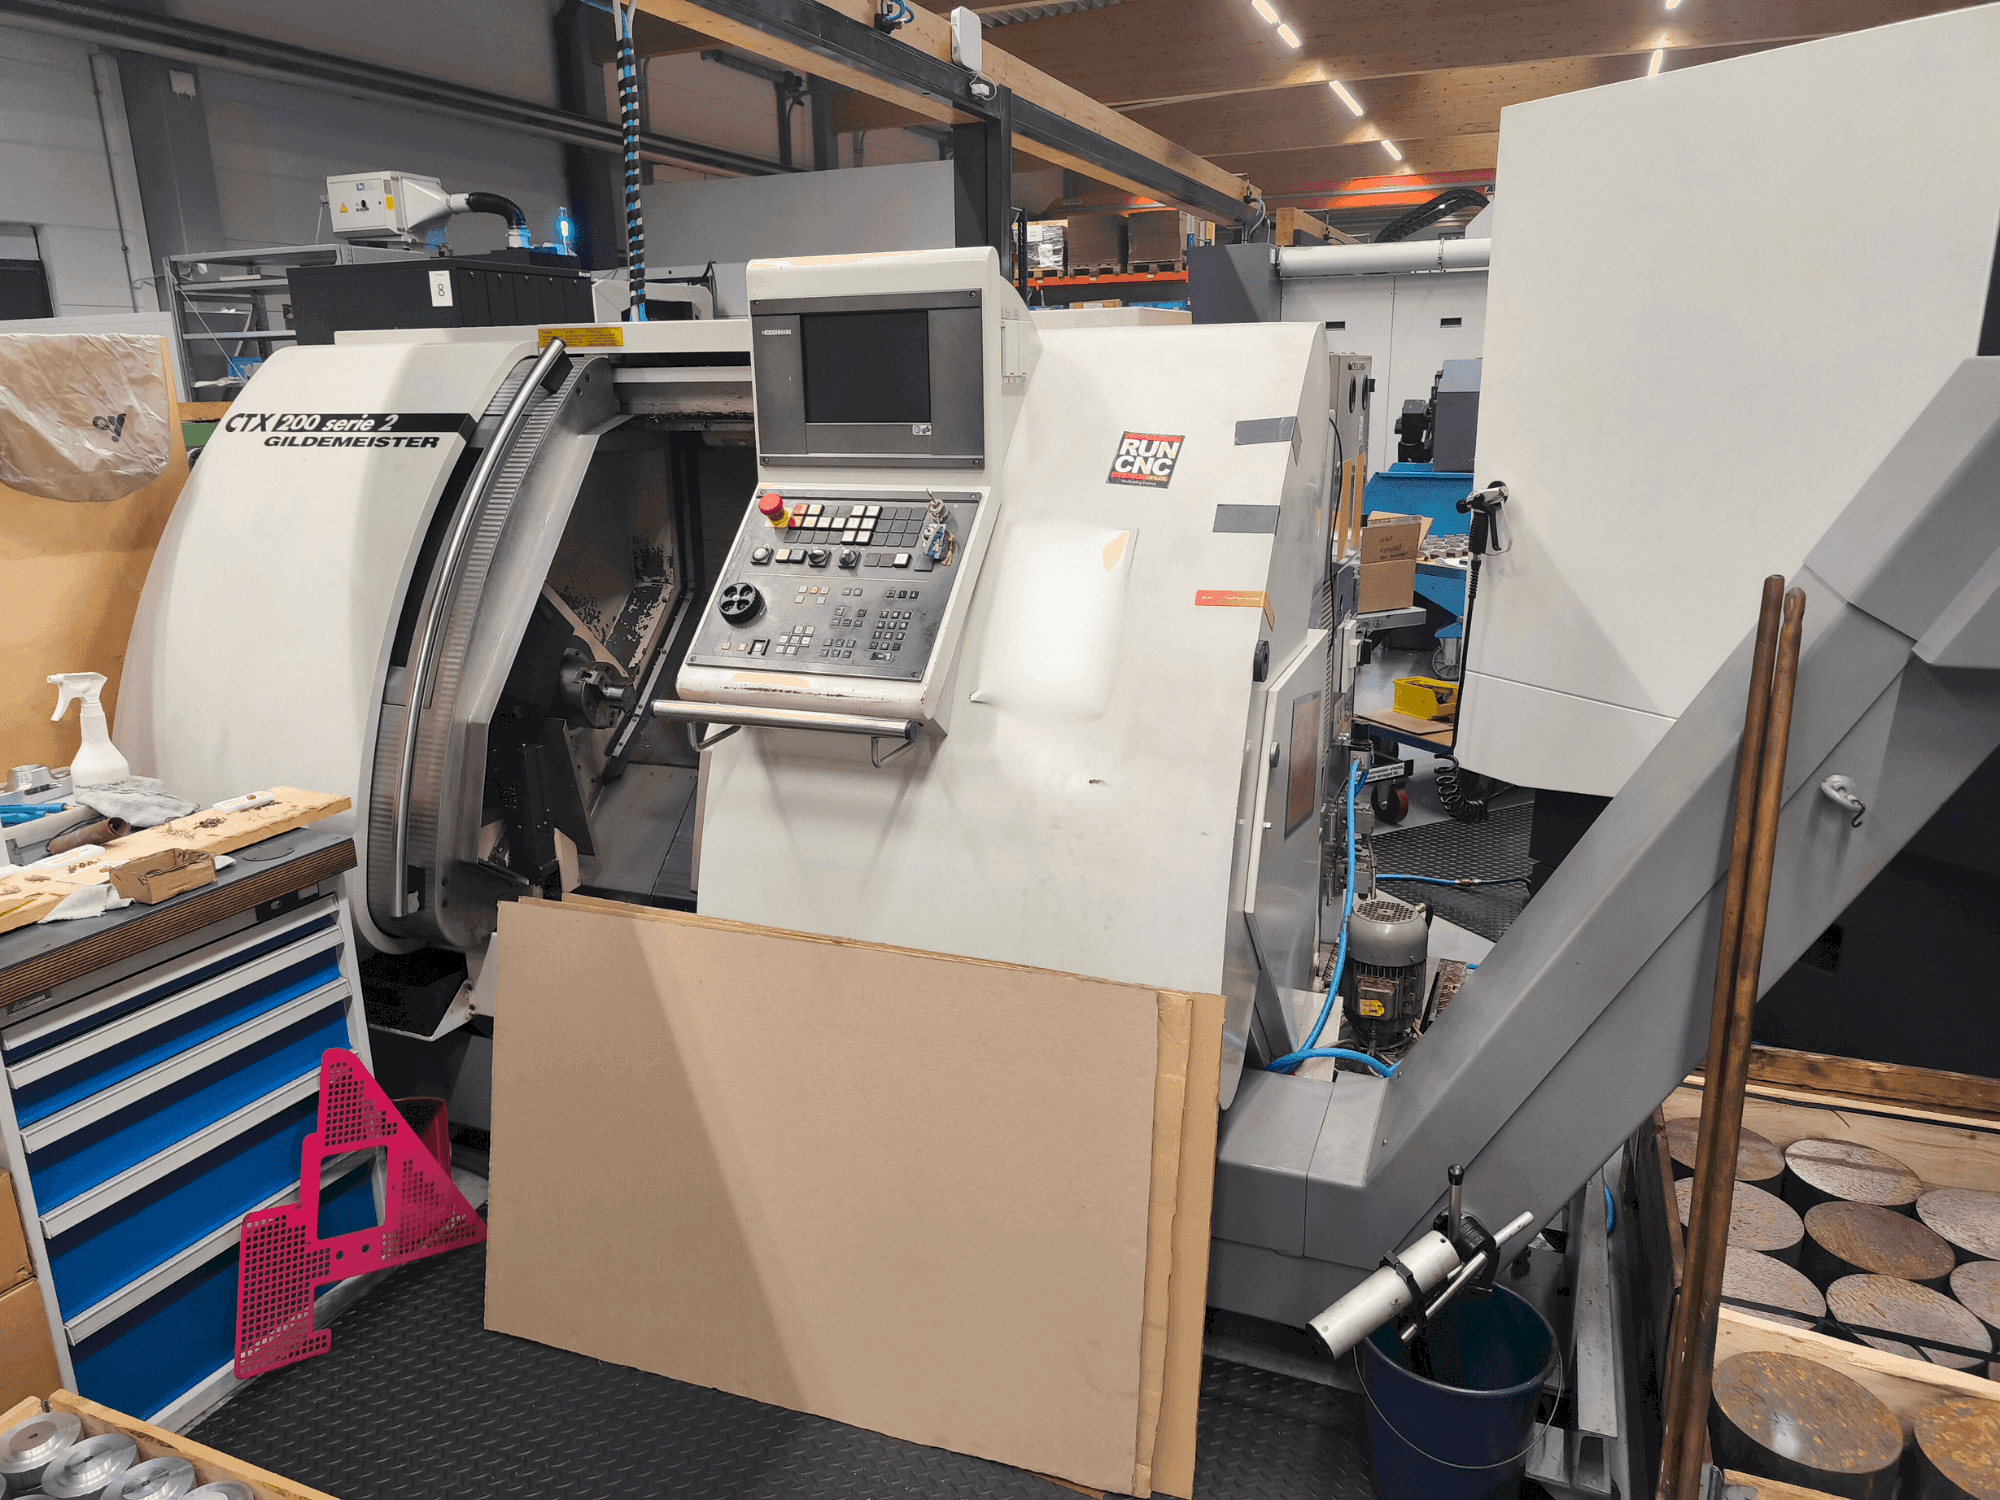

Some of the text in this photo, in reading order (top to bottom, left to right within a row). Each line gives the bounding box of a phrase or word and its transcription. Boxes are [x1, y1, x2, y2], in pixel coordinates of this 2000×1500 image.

[437, 283, 446, 297] 8
[225, 412, 399, 433] CTX 200 serie 2
[263, 435, 441, 449] GILDEMEISTER
[1118, 438, 1181, 459] RUN
[1114, 455, 1173, 476] CNC
